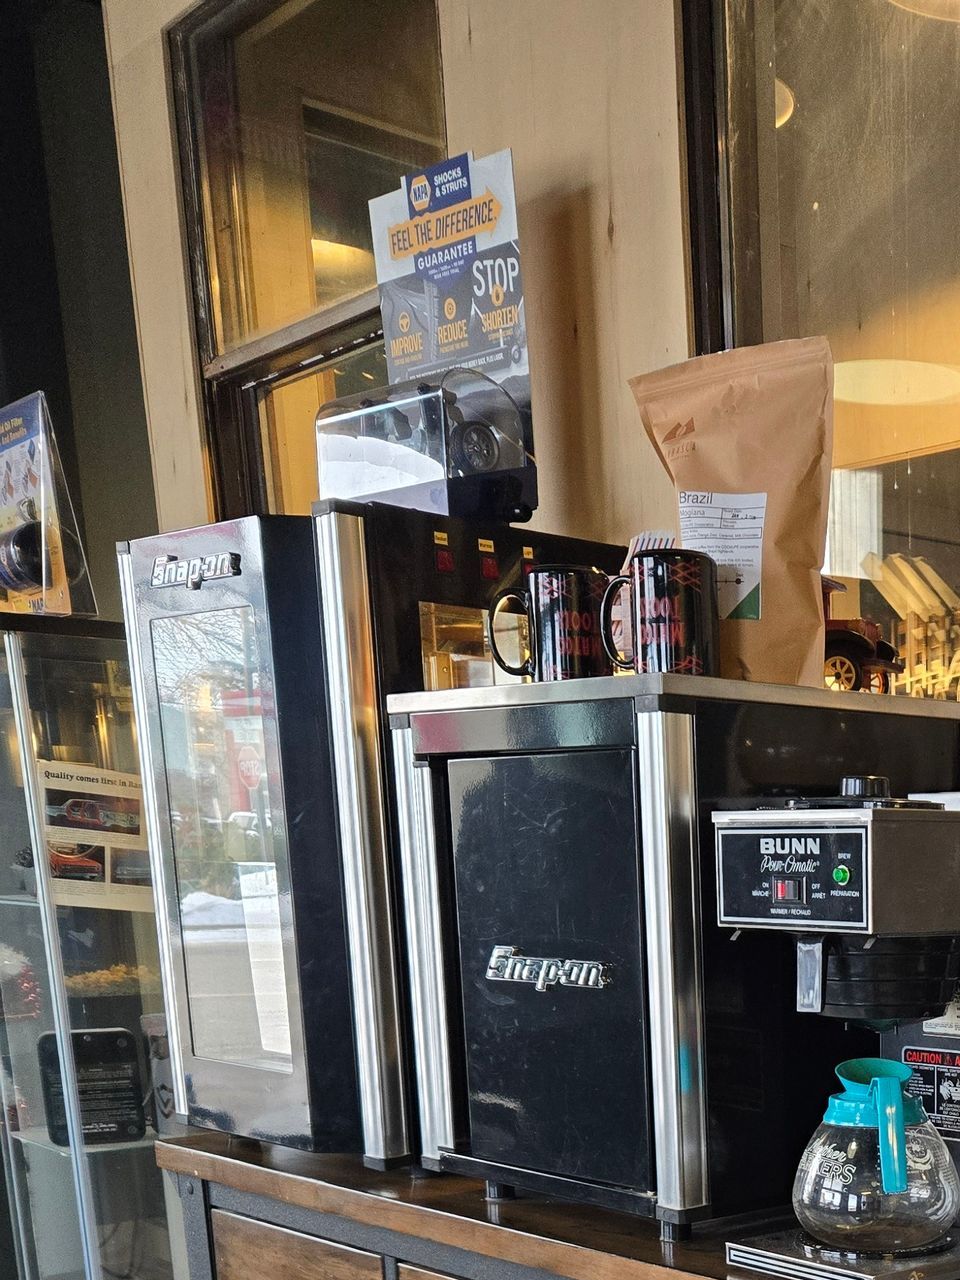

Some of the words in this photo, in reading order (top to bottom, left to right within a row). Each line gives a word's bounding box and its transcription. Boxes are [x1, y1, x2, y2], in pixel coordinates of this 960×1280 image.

[433, 166, 462, 187] SHOCKS
[435, 186, 441, 198] &
[441, 176, 468, 196] STRUTS
[412, 184, 429, 203] NAPA
[391, 227, 414, 255] FEEL
[414, 219, 433, 246] THE
[417, 241, 474, 270] GUARANTEE
[472, 257, 520, 297] STOP
[481, 304, 519, 333] SHORTEN
[390, 332, 424, 358] IMPROVE
[437, 319, 469, 345] REDUCE
[680, 491, 713, 505] Brazil
[151, 551, 236, 590] Snap-on
[44, 770, 75, 782] Quality
[75, 775, 100, 784] comes
[100, 777, 117, 786] first
[760, 837, 821, 855] BUNN
[485, 945, 604, 992] Snap-on
[906, 1051, 942, 1064] CAUTION
